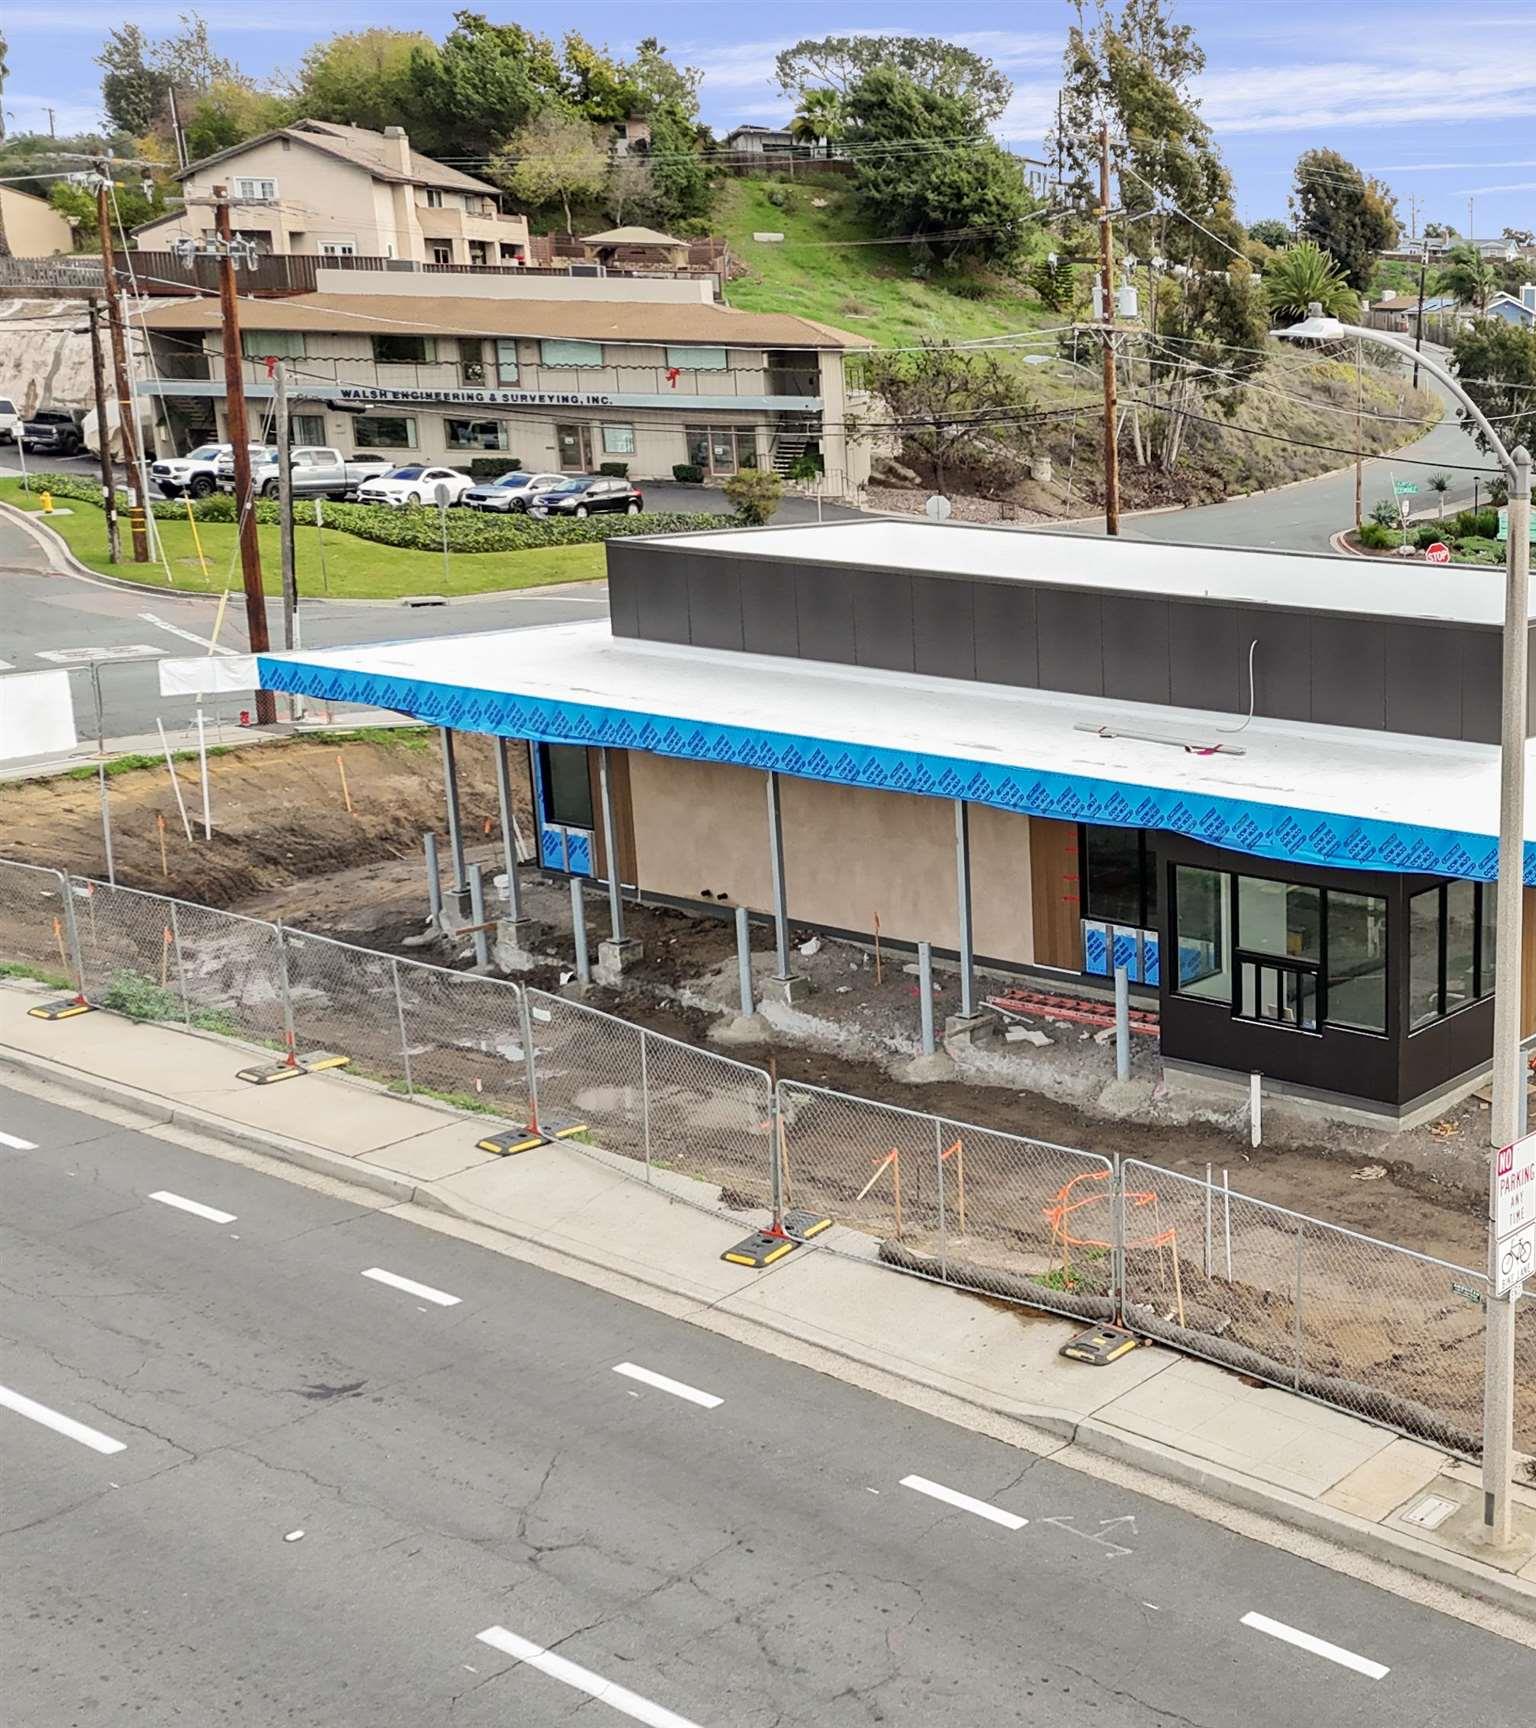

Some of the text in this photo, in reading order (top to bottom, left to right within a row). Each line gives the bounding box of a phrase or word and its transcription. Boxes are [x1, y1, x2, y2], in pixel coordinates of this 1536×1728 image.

[340, 389, 613, 405] WALSH ENGINEERING & SURVEYING, INC.
[1428, 551, 1448, 562] STOP
[1500, 1147, 1512, 1173] NO
[1500, 1163, 1535, 1196] PARKING
[1511, 1192, 1523, 1208] ANY
[1509, 1206, 1525, 1225] TIME
